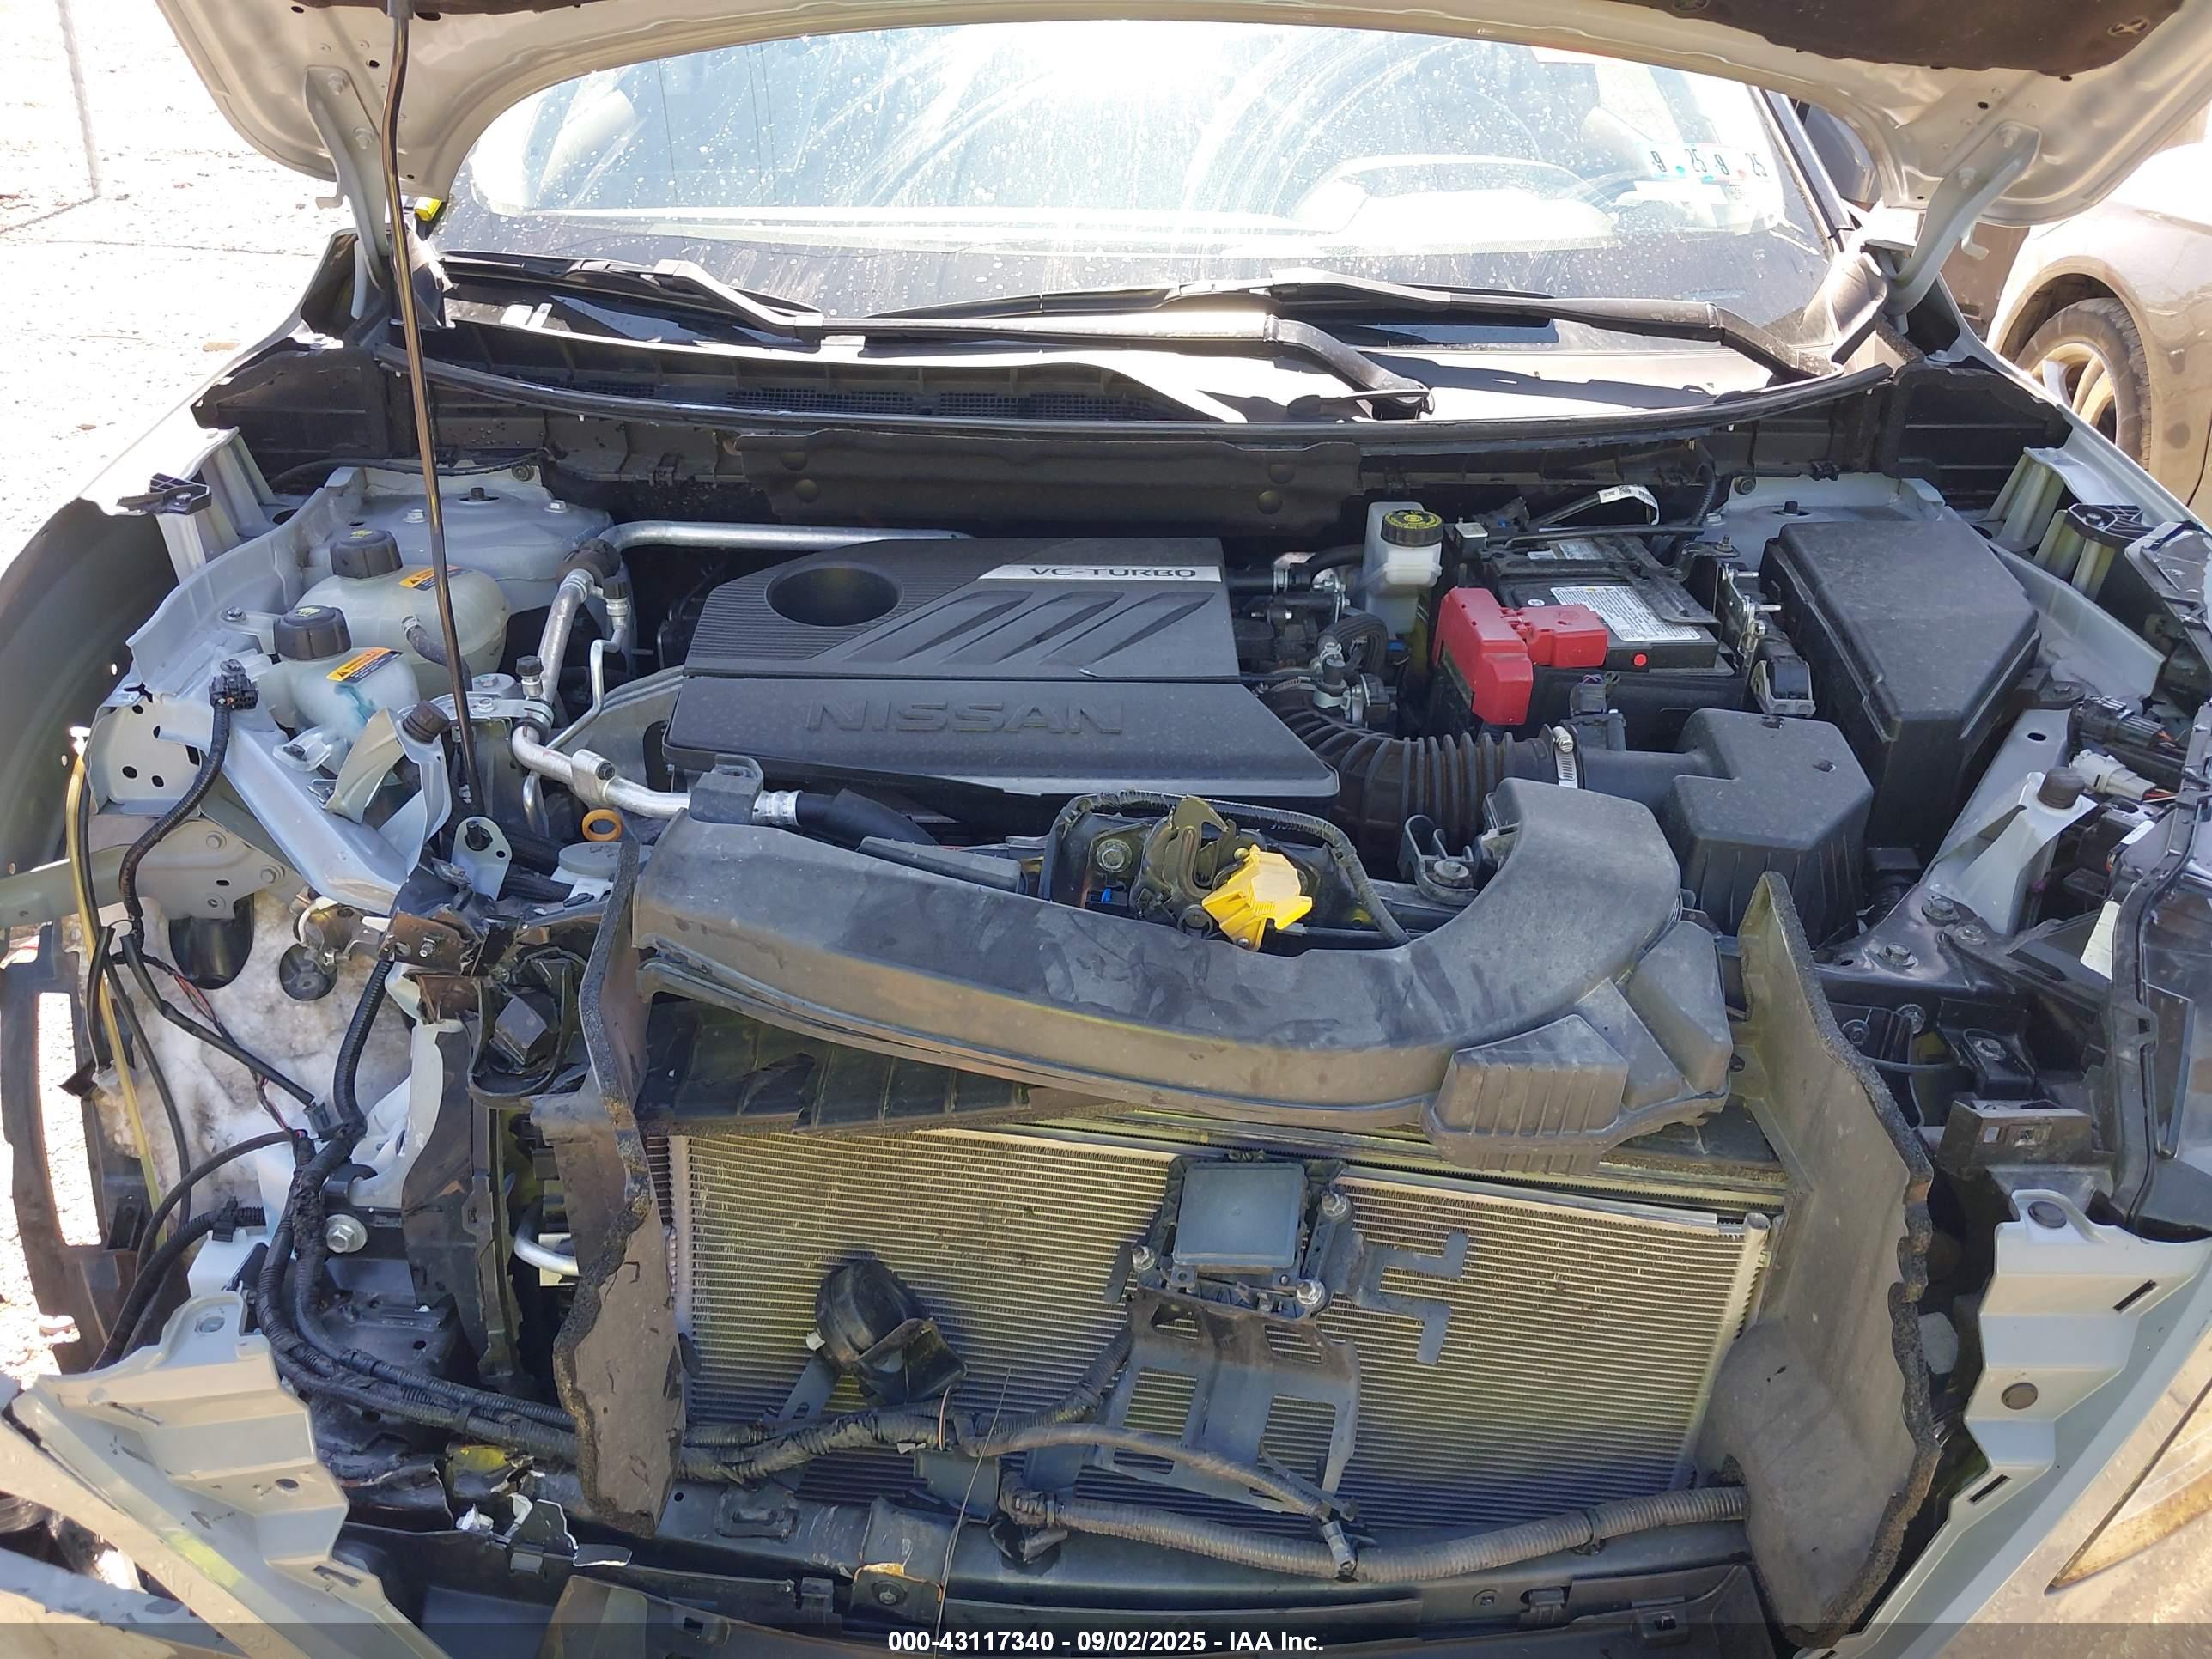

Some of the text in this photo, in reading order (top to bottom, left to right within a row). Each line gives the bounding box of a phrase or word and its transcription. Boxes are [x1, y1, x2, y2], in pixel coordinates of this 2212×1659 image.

[1650, 150, 1668, 173] 9
[1713, 154, 1729, 176] 9
[1030, 567, 1196, 578] VC-TURBO
[805, 700, 1123, 734] NISSAN
